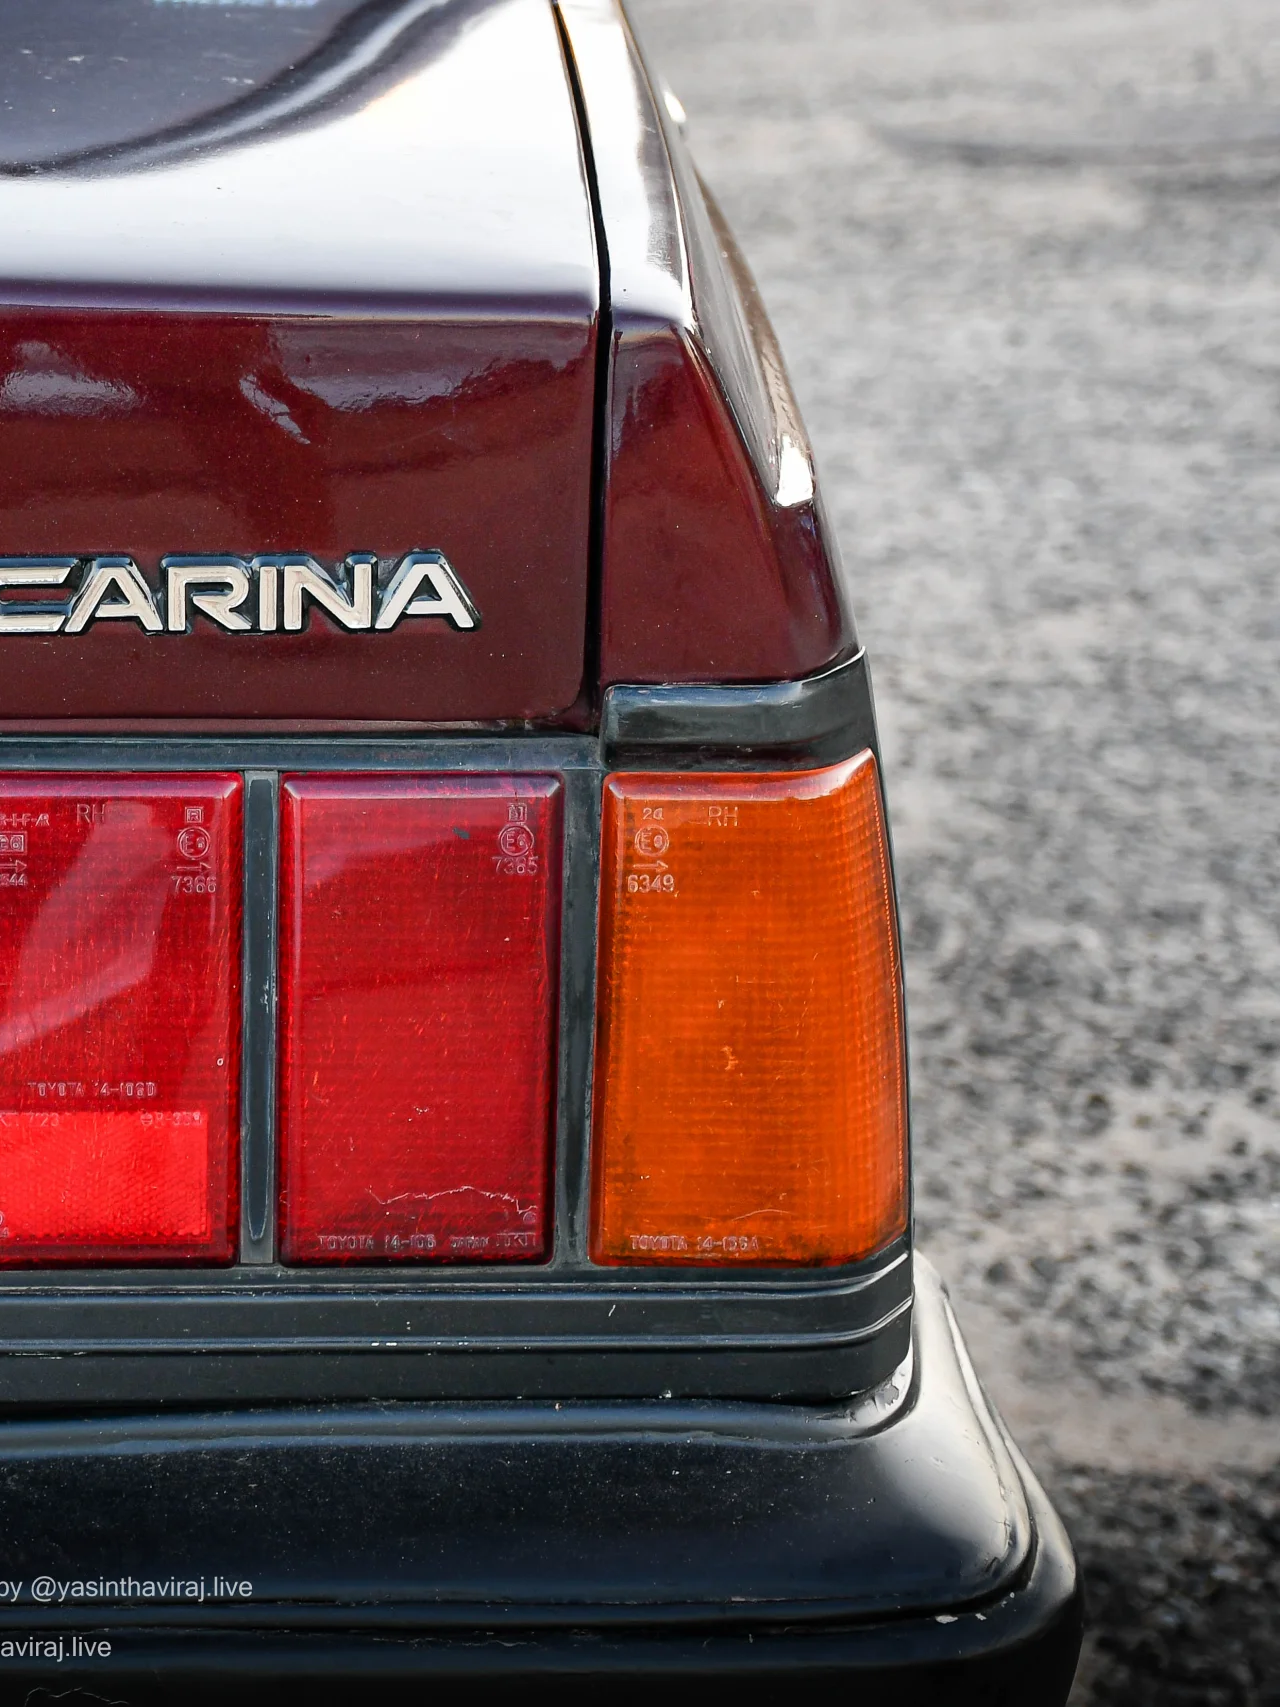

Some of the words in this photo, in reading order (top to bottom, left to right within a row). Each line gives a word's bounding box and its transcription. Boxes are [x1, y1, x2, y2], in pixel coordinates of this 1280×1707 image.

[76, 803, 106, 824] RH
[708, 806, 738, 827] RH
[172, 875, 217, 893] 7366
[627, 874, 675, 894] 6349
[28, 1081, 85, 1097] TOYOTA
[317, 1234, 375, 1250] TOYOTA
[629, 1235, 688, 1251] TOYOTA
